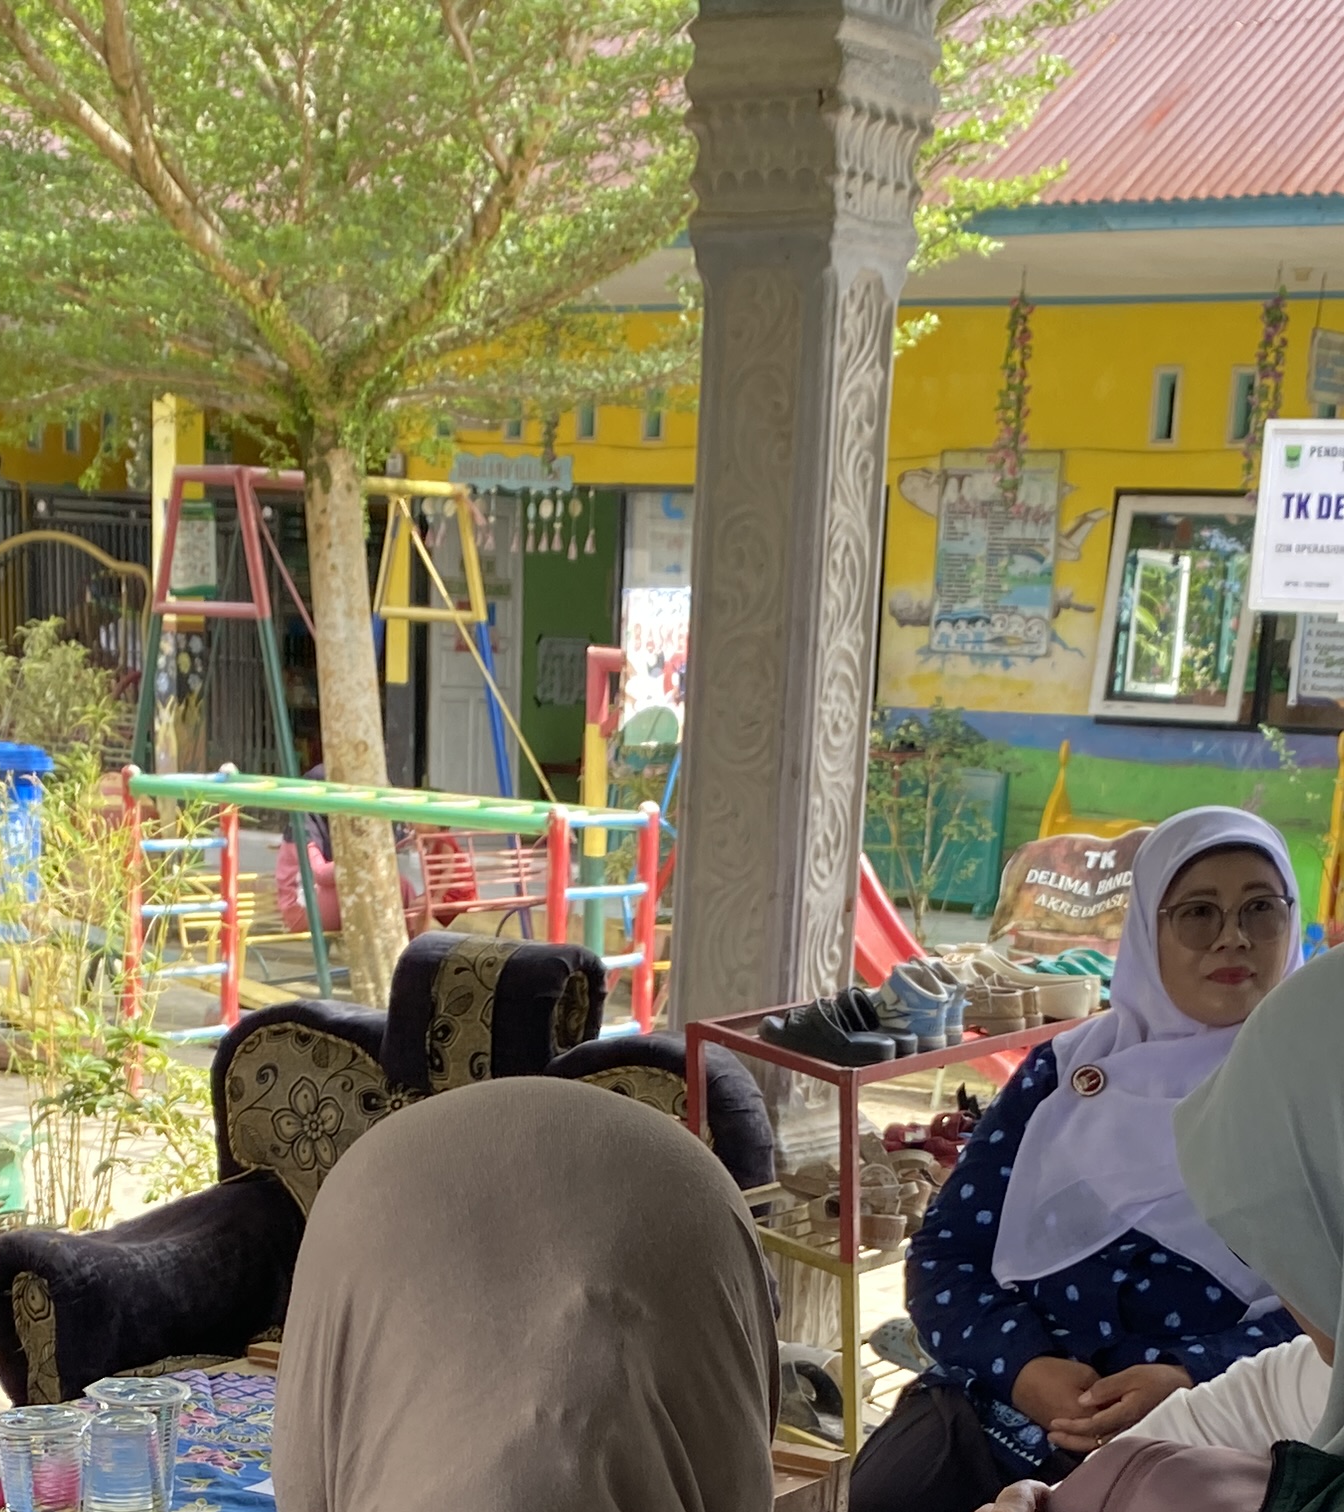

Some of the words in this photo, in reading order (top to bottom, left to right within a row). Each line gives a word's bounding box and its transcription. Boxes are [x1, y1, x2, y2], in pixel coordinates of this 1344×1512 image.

[1282, 493, 1311, 519] TK
[1084, 849, 1117, 869] TK
[1025, 869, 1090, 896] DELIMA
[1095, 870, 1133, 896] BAND
[1035, 893, 1124, 918] AKREDITASI
